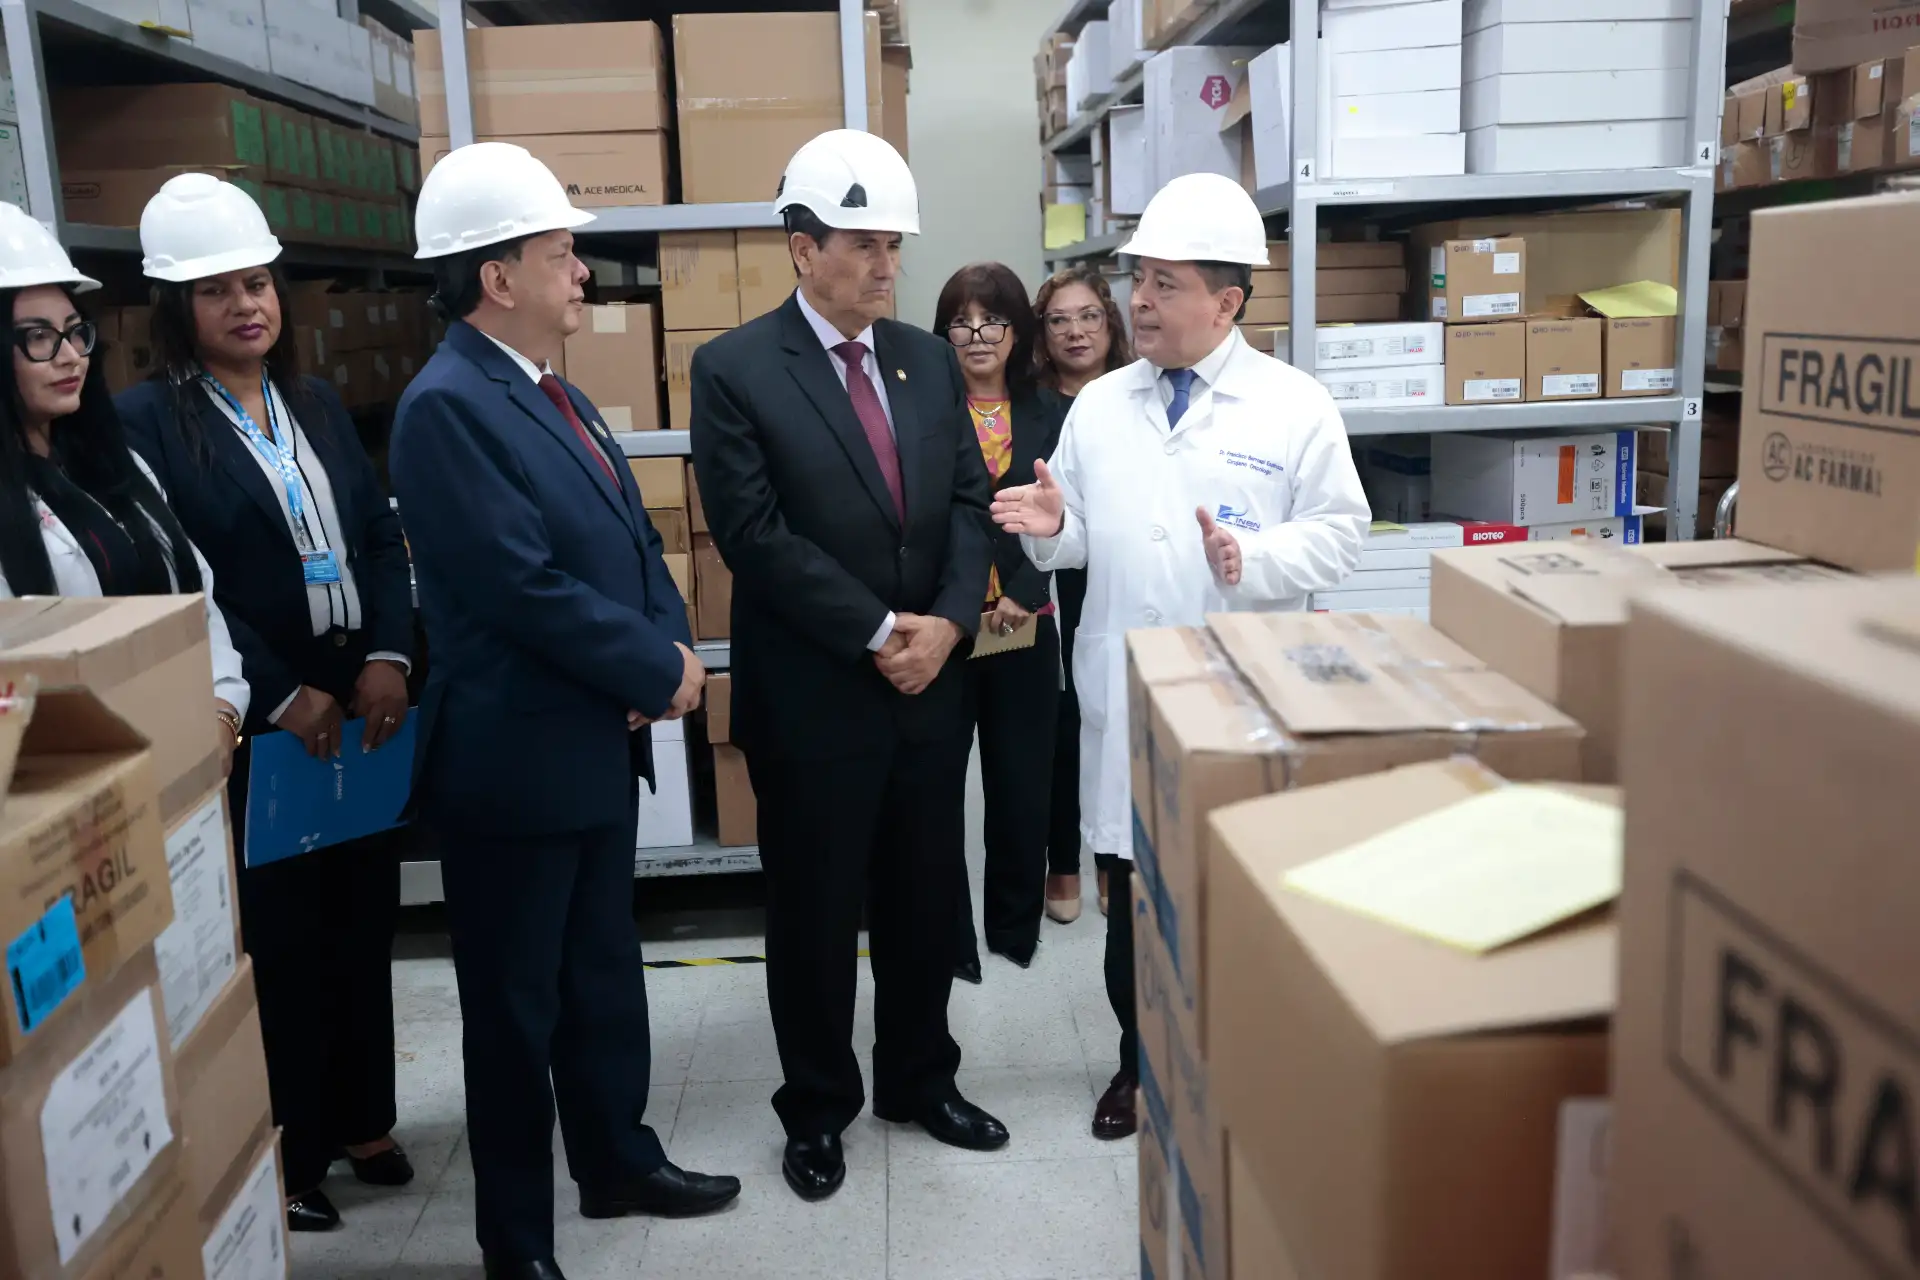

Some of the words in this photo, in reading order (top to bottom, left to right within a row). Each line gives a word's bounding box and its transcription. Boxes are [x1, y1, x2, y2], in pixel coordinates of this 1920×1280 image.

[1211, 79, 1222, 106] MDL
[1699, 146, 1710, 161] 4
[1300, 163, 1311, 177] 4
[584, 186, 603, 195] ACE
[604, 184, 647, 194] MEDICAL
[1778, 348, 1920, 419] FRAGIL
[1686, 402, 1698, 417] 3
[1794, 454, 1814, 482] AC
[1818, 458, 1875, 494] FARMA
[44, 847, 137, 915] RAGIL
